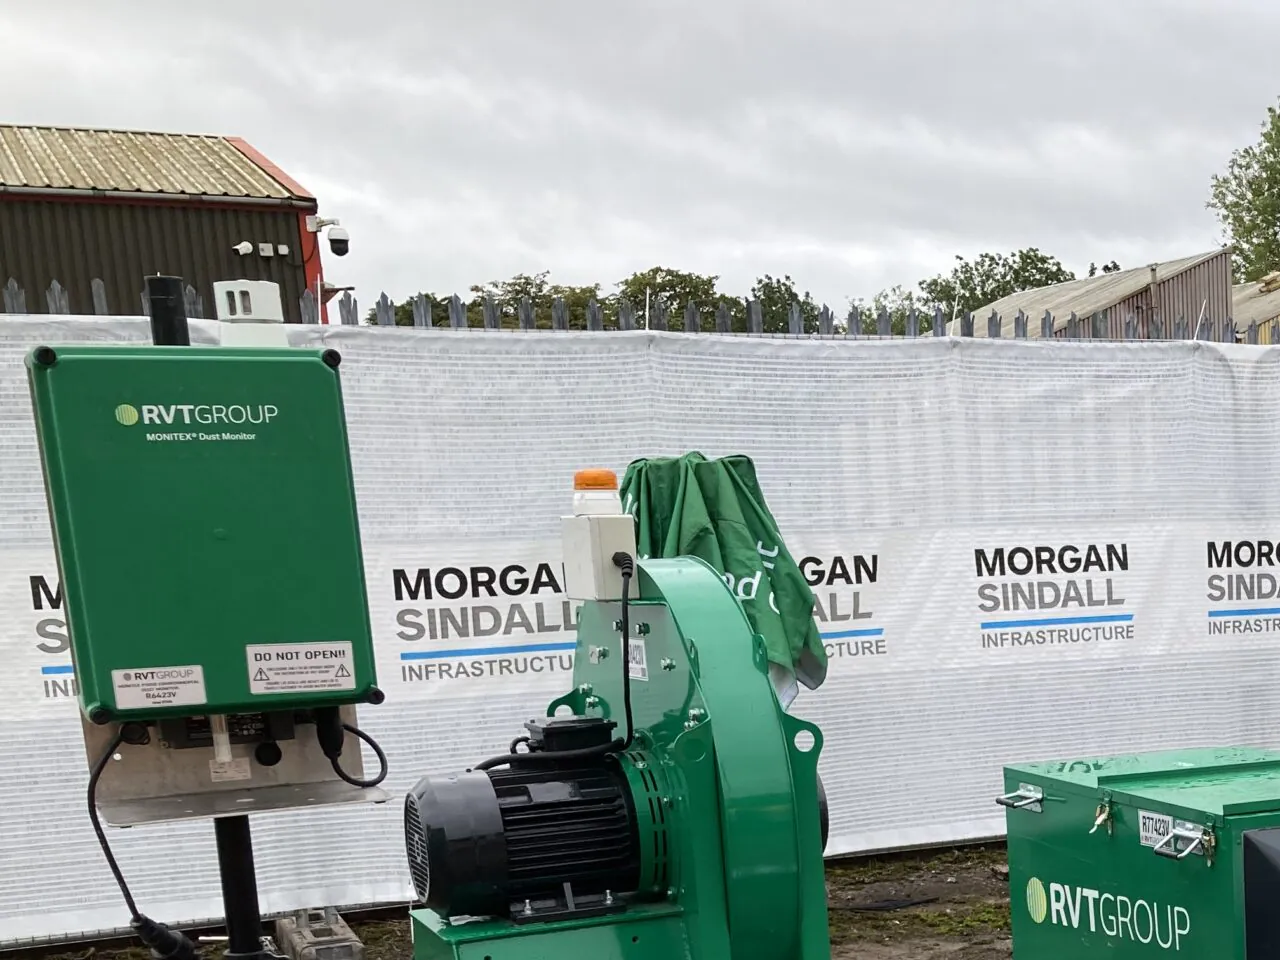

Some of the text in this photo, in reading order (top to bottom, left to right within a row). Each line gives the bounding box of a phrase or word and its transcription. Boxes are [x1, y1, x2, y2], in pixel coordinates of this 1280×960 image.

[141, 405, 278, 425] RVTGROUP
[198, 433, 220, 441] Dust
[221, 432, 256, 441] Monitor
[798, 554, 878, 587] GAN
[974, 543, 1129, 577] MORGAN
[393, 562, 567, 601] MORGA
[978, 578, 1126, 612] SINDALL
[396, 600, 578, 642] SINDALL
[981, 625, 1134, 648] INFRASTRUCTURE
[254, 649, 345, 662] DO NOT OPEN!!
[401, 654, 573, 683] INFRASTRUCTU
[134, 669, 194, 681] RVTGROUP
[1049, 882, 1191, 951] RVTGROUP
